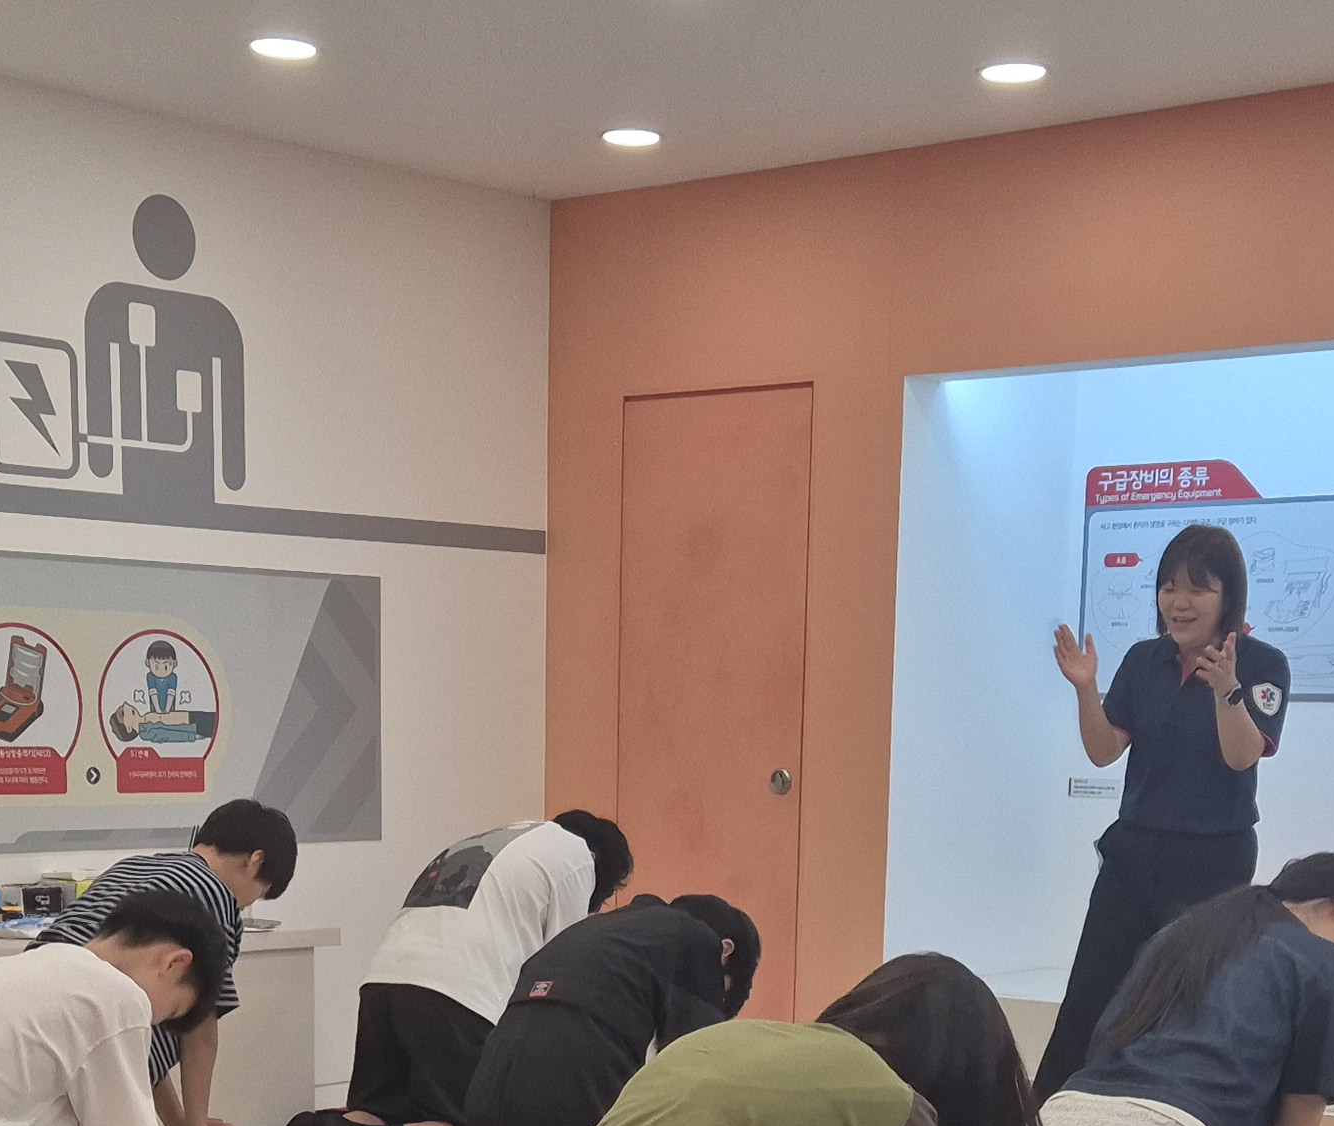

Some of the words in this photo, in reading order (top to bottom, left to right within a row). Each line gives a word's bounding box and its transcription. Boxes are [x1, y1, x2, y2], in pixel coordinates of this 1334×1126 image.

[1098, 468, 1174, 492] 구급장비의
[1177, 466, 1210, 488] 종류
[1095, 494, 1119, 504] Types
[1121, 492, 1130, 501] of
[1131, 490, 1177, 502] Emergency
[1178, 488, 1222, 500] Equipment
